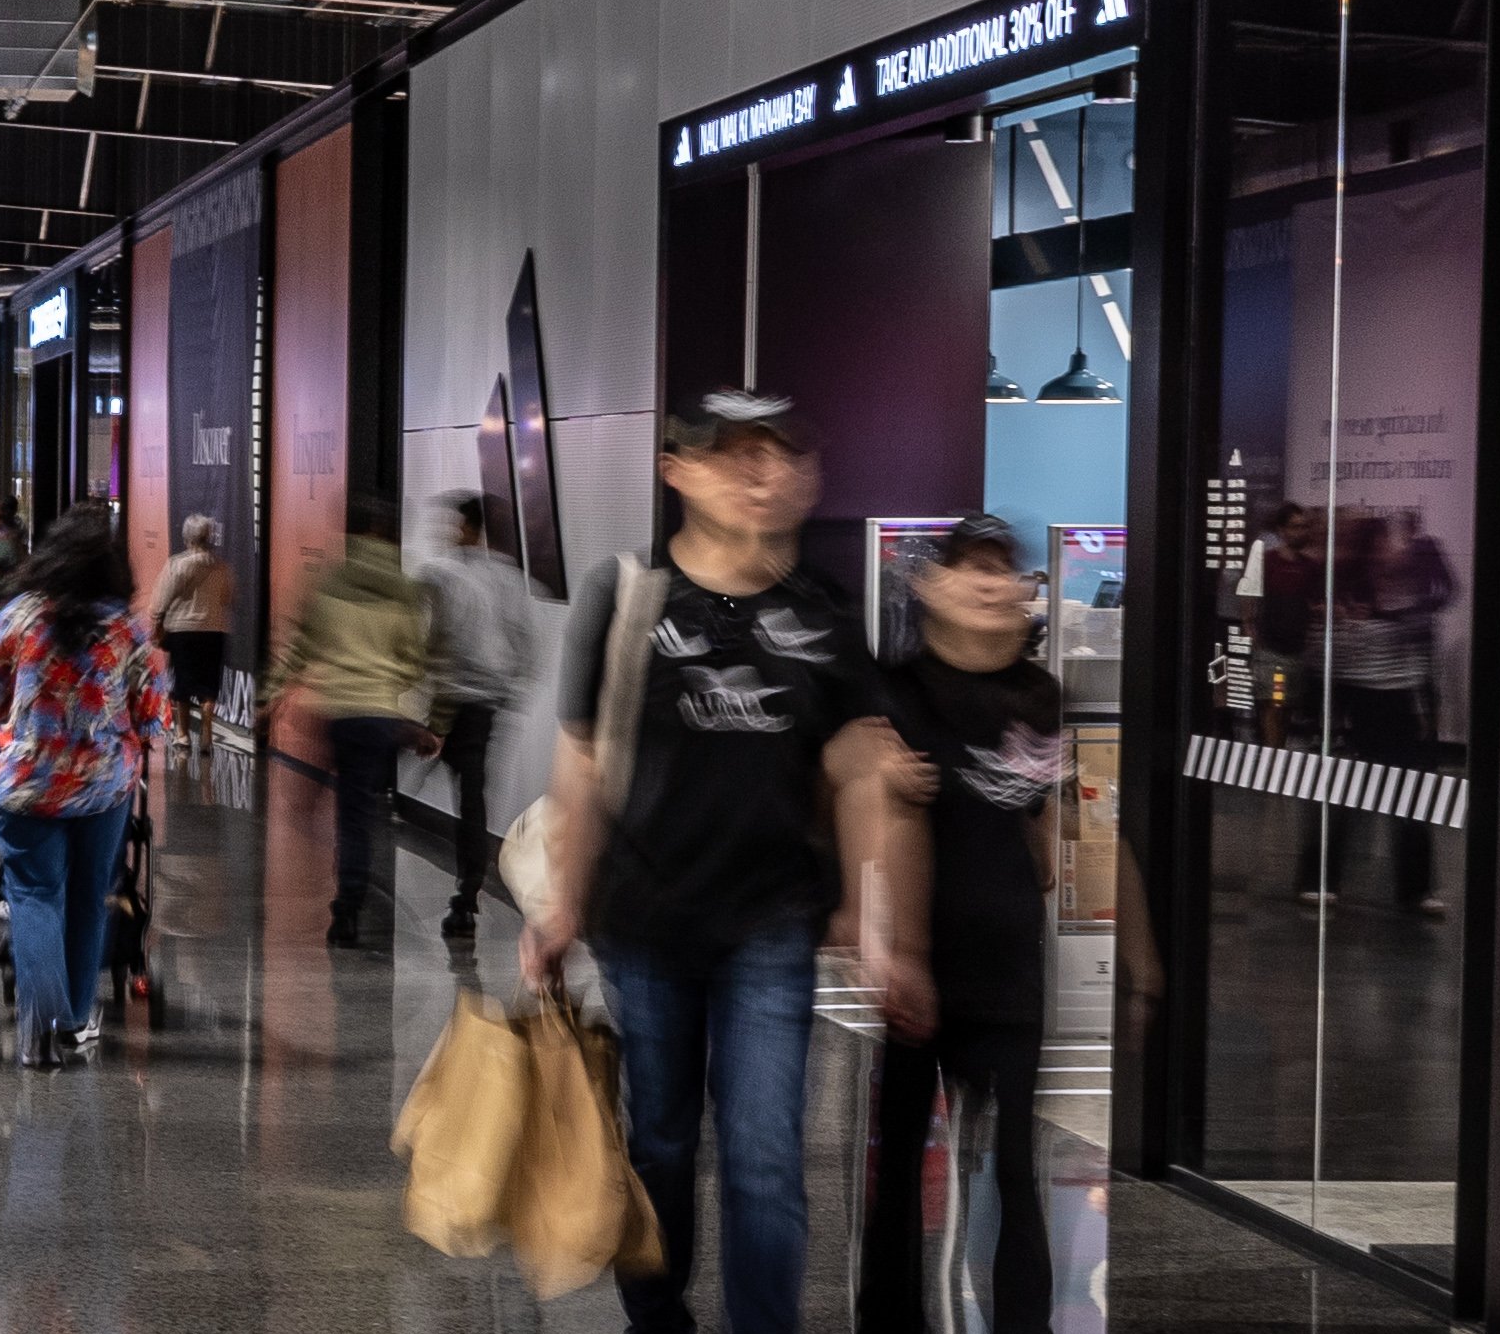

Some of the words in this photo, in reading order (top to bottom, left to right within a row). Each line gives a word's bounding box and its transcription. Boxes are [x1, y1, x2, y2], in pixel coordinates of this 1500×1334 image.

[876, 50, 909, 97] TAKE
[908, 43, 929, 88] AN
[928, 14, 1009, 80] ADDITIONAL
[1008, 1, 1044, 54] 30%
[794, 83, 818, 125] BAY
